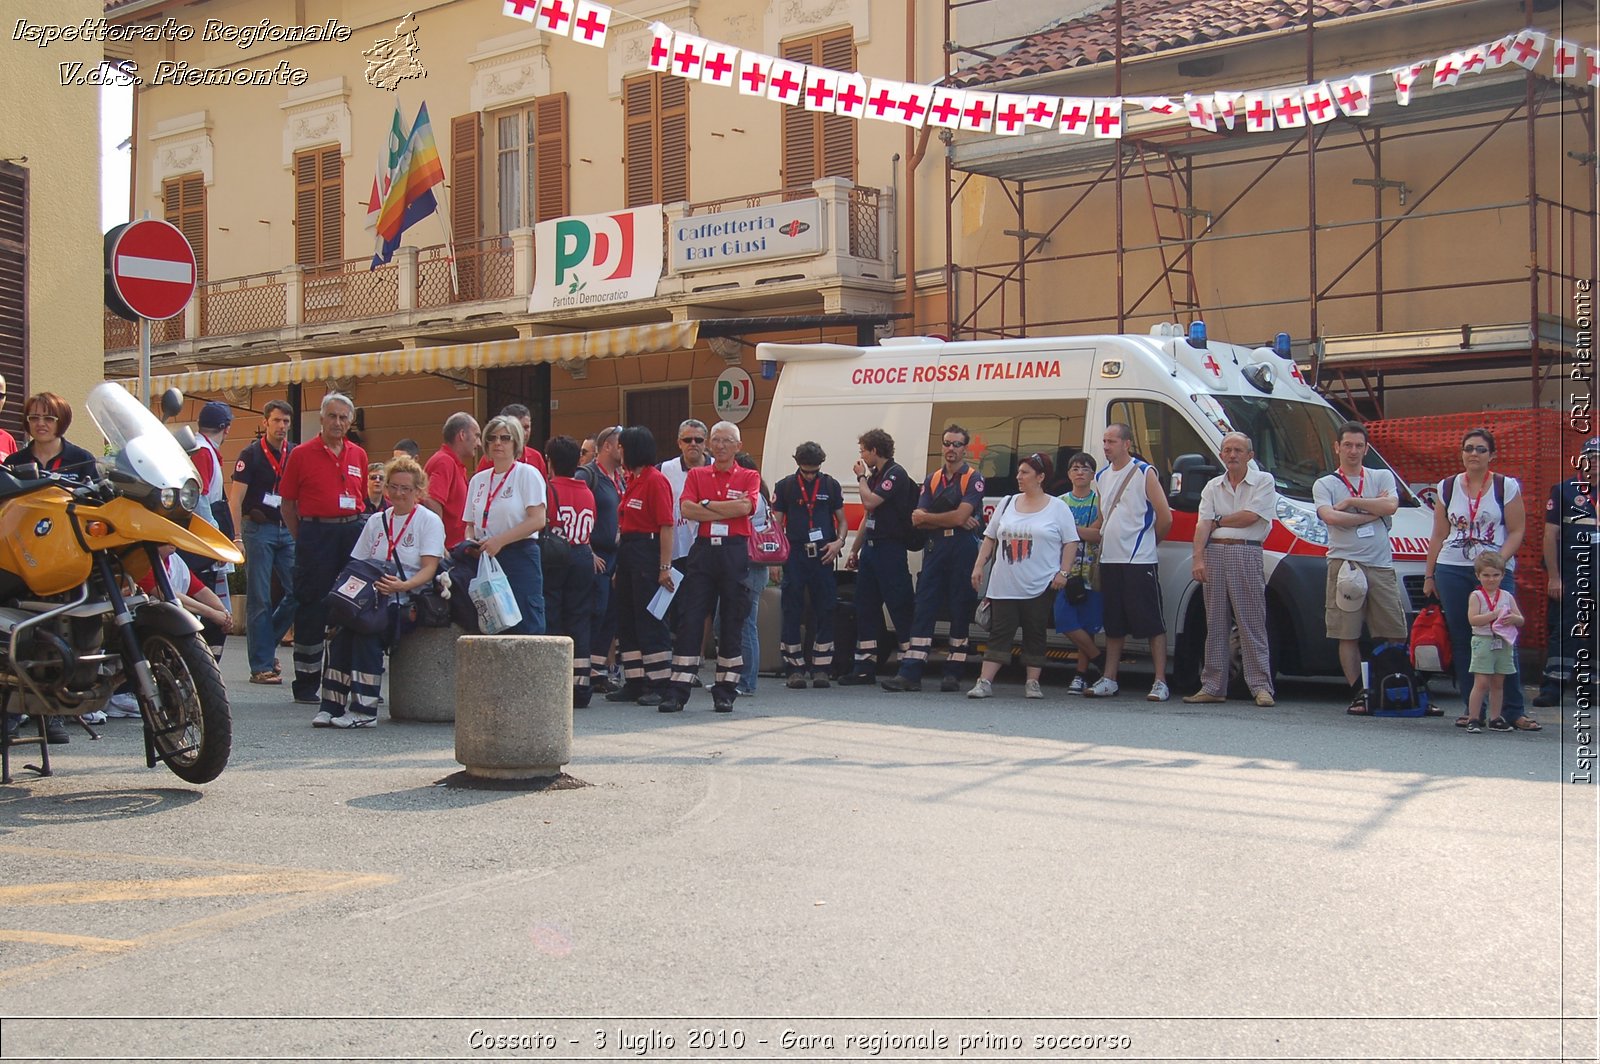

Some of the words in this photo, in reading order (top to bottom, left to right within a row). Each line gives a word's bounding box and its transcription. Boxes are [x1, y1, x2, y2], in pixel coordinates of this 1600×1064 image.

[677, 216, 775, 241] Caffetteria
[555, 212, 634, 286] PD
[687, 246, 716, 260] Bar
[721, 236, 766, 256] Giusi
[552, 296, 575, 308] Partito
[580, 289, 629, 304] Democratico
[851, 367, 908, 385] CROCE
[912, 364, 970, 383] ROSSA
[976, 360, 1062, 380] ITALIANA
[717, 379, 750, 407] PD
